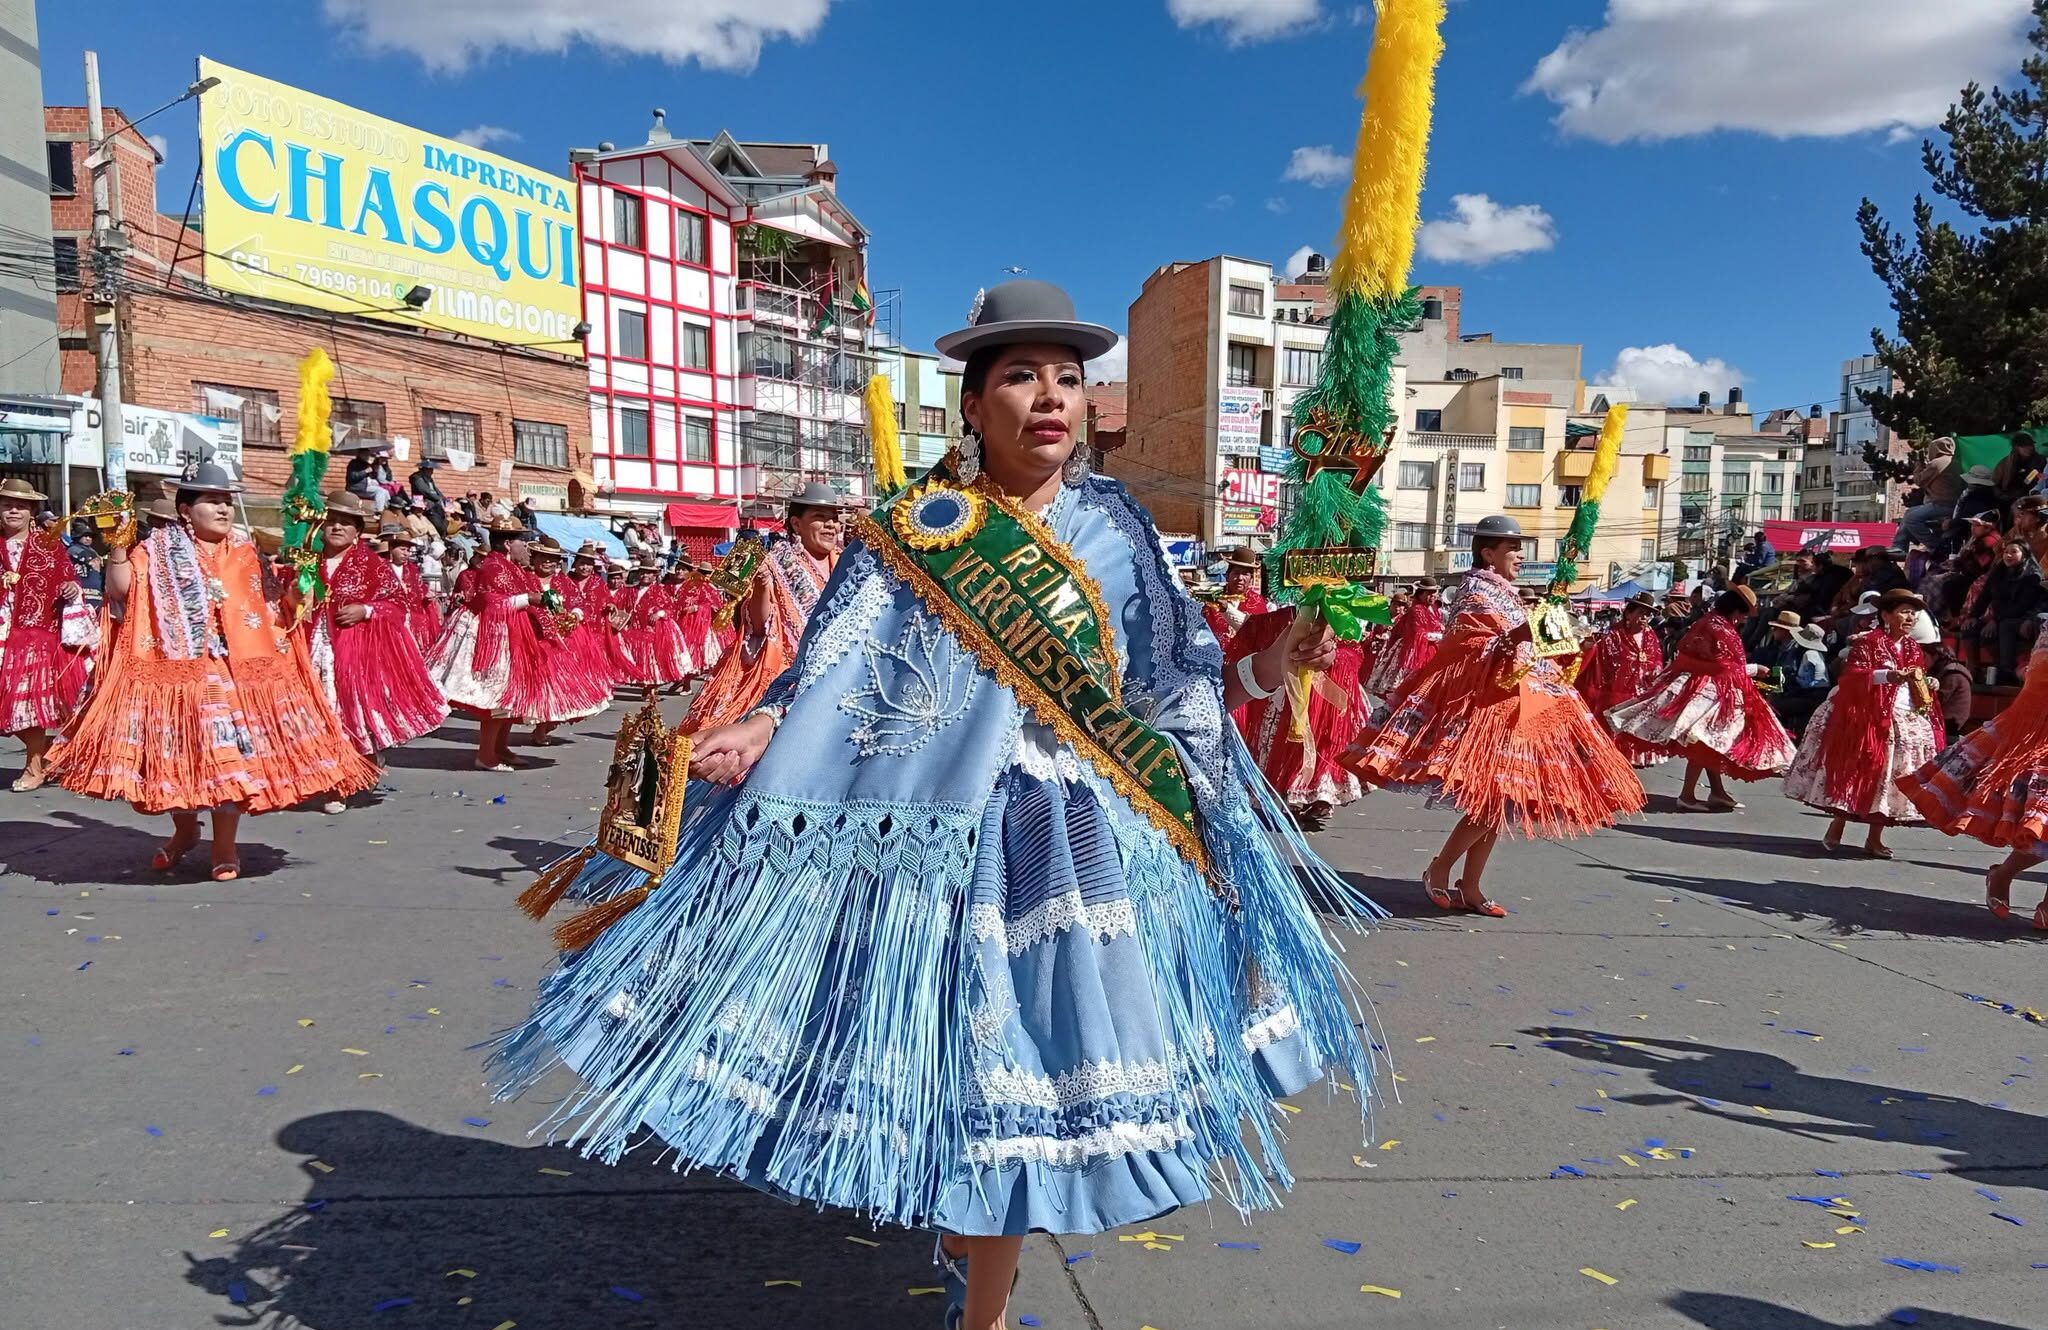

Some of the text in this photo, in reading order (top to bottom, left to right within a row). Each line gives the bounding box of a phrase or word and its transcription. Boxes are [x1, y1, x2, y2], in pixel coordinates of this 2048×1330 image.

[297, 102, 411, 163] ESTUDIO
[215, 127, 577, 289] CHASQUI
[422, 143, 572, 213] IMPRENTA
[296, 263, 392, 299] 79696104
[129, 450, 153, 465] con
[1225, 471, 1277, 506] CINE
[1444, 462, 1456, 544] FARMACIA
[1000, 543, 1089, 640] REINA
[1287, 552, 1375, 577] VERENISSE
[941, 547, 1175, 787] VERENISSE CALLE
[602, 823, 660, 864] VERENISSE
